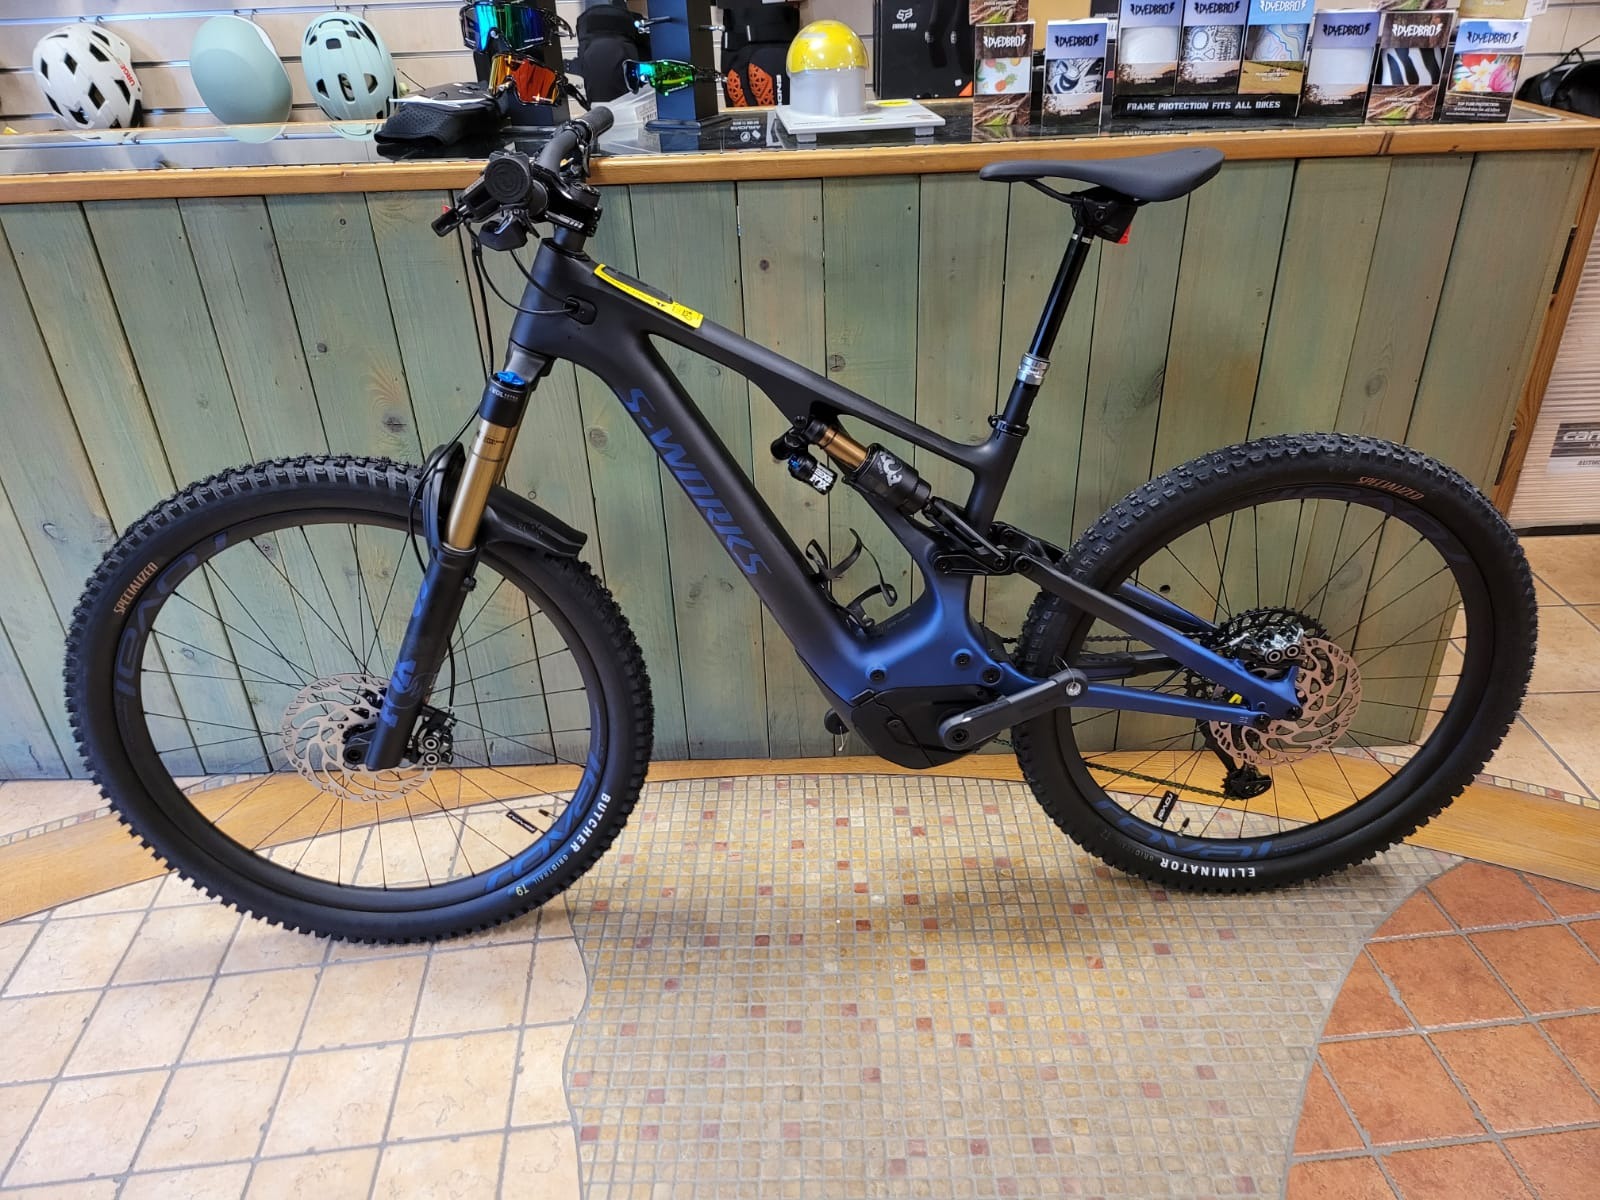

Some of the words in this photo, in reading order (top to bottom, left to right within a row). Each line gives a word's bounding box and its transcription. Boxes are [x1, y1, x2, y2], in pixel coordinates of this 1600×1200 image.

[1327, 24, 1364, 36] DYEDBRO
[1396, 24, 1435, 37] DYEDBRO
[988, 35, 1021, 48] DYEDBRO
[1059, 35, 1093, 48] DYEDBRO
[1471, 32, 1511, 44] DYEDBRO
[1126, 102, 1155, 111] FRAME
[1158, 101, 1208, 110] PROTECTION
[1212, 101, 1231, 110] FITS
[1235, 100, 1252, 109] ALL
[1255, 100, 1281, 109] BIKES
[617, 387, 772, 575] S-WORKS
[113, 561, 159, 616] SPECIALIZED
[570, 793, 612, 853] BUTCHER
[1160, 857, 1256, 878] ELIMINATOR
